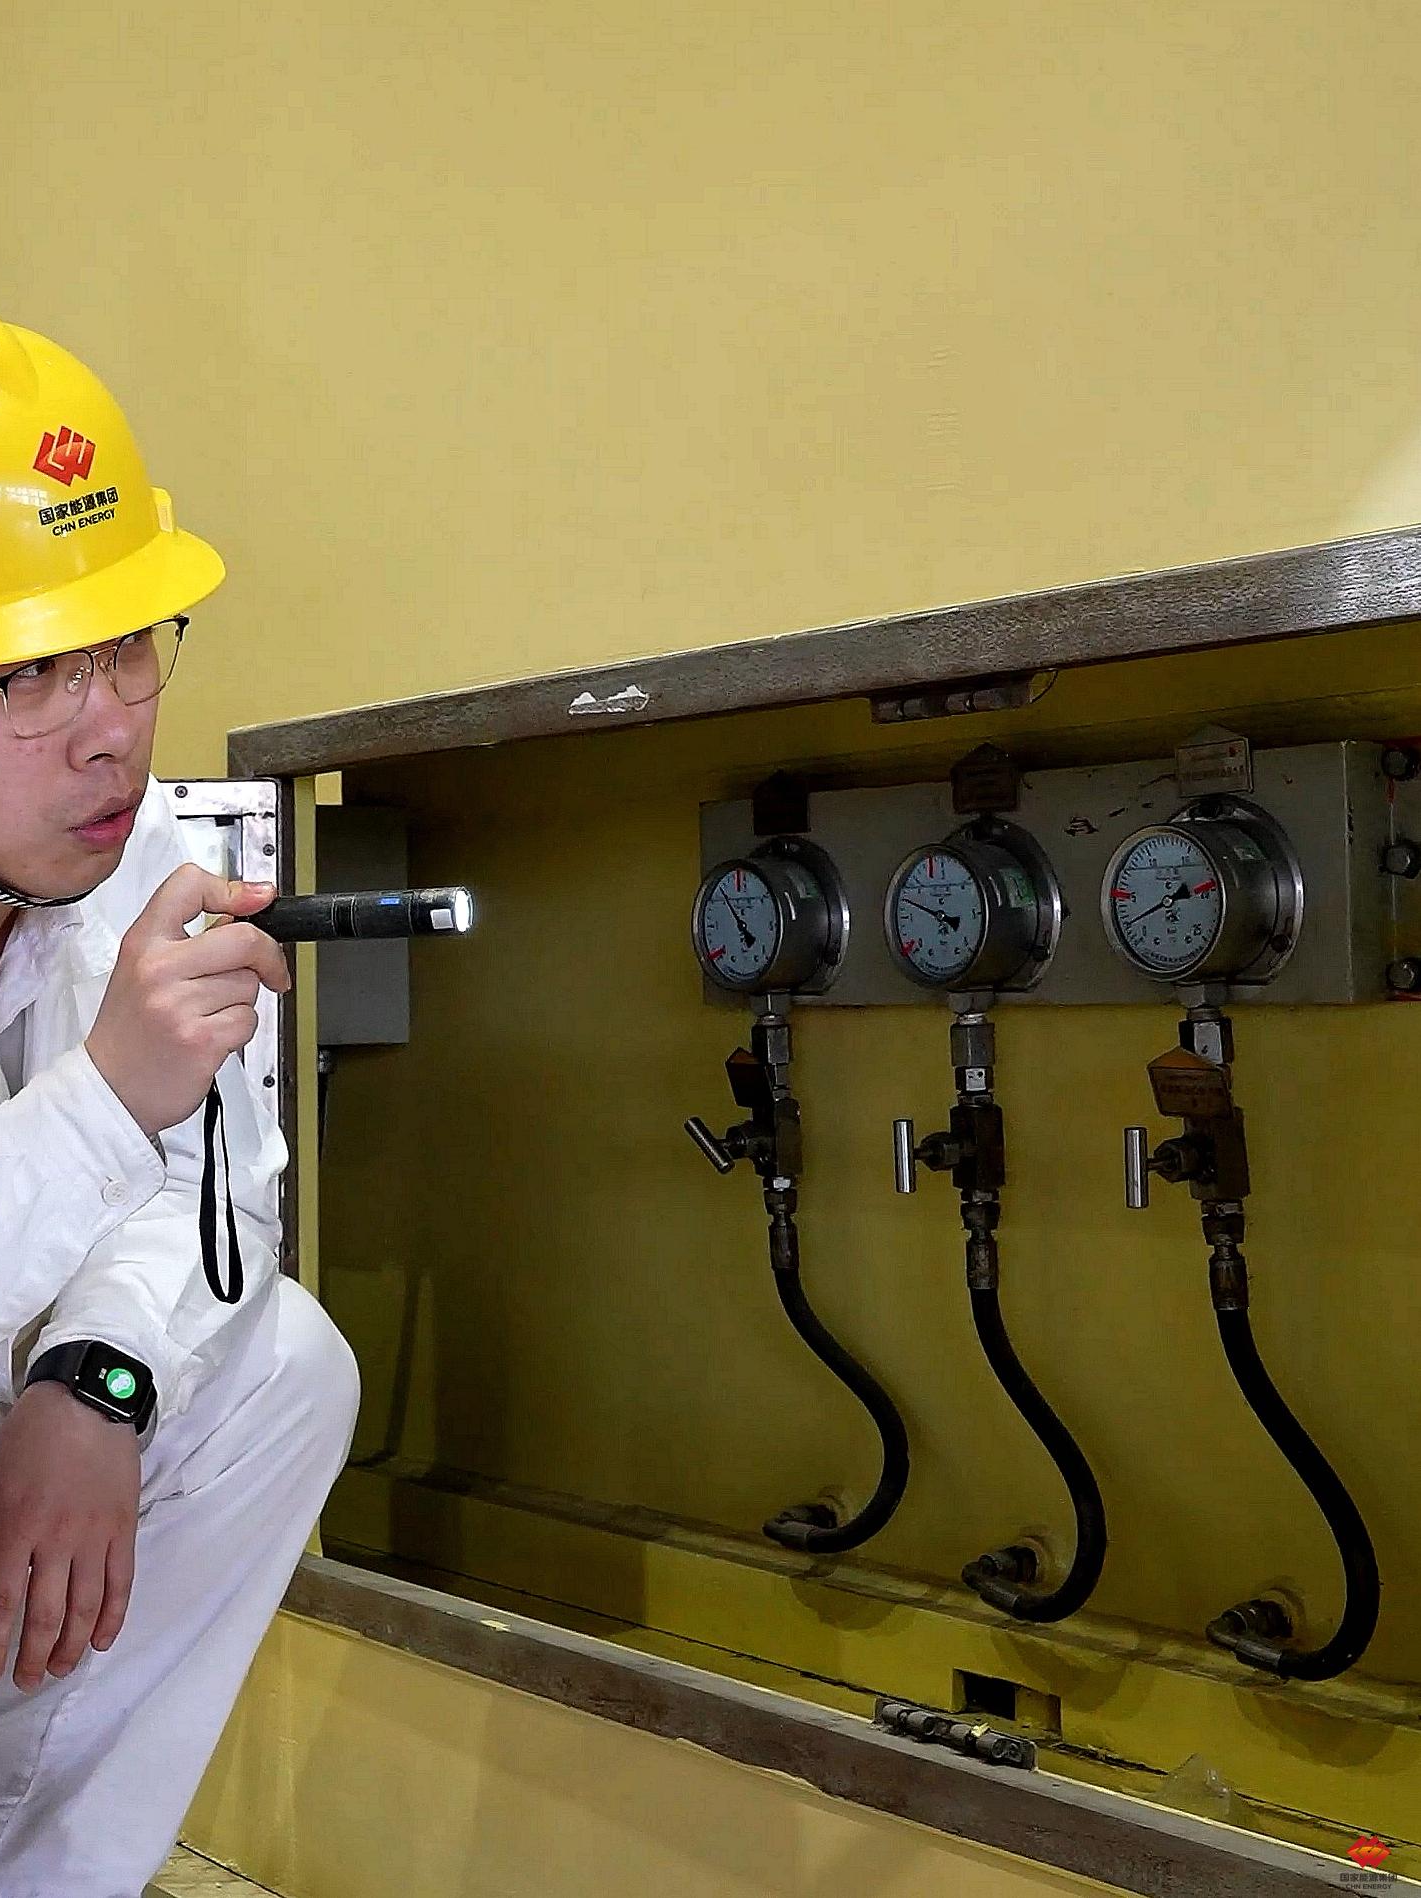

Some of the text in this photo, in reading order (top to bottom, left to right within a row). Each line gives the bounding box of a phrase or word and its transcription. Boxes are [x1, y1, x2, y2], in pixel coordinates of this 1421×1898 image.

[39, 487, 118, 525] 国家能源集团
[52, 508, 115, 536] CHN ENERGY
